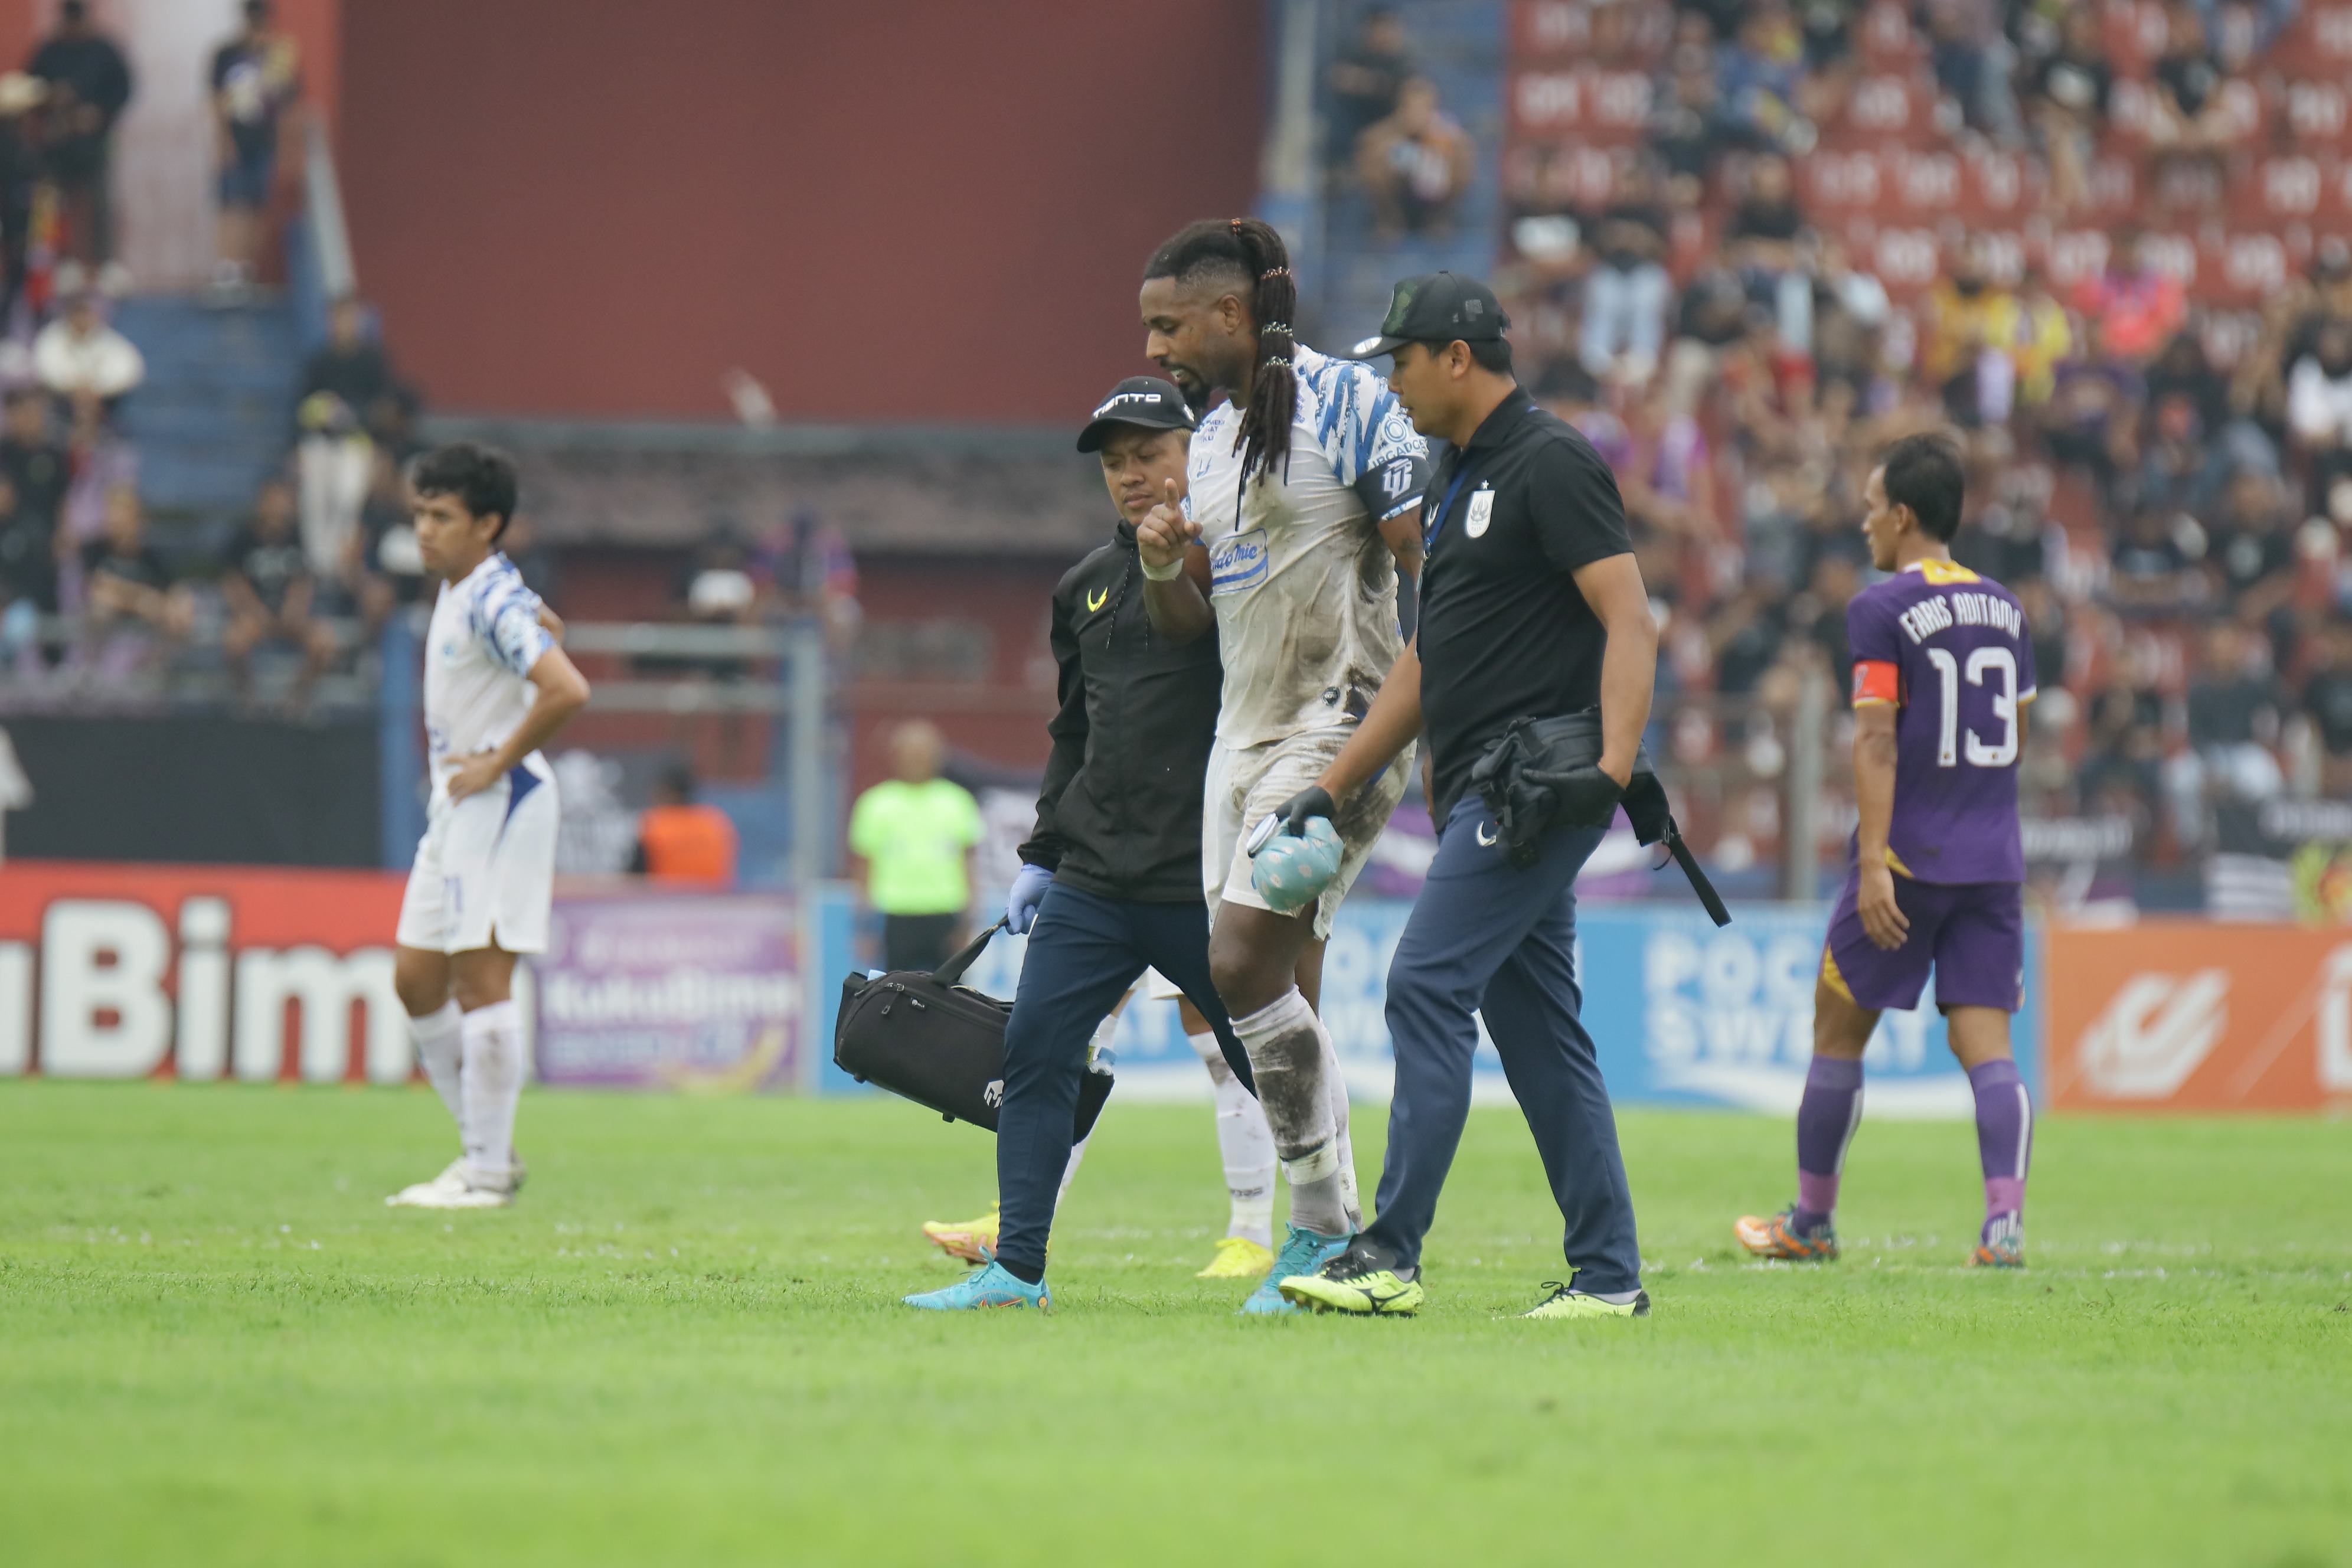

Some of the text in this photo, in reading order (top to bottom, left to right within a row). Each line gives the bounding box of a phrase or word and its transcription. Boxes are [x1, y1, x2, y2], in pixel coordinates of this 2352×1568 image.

[1899, 592, 2021, 645] FARIS ADITAMA
[1928, 646, 2019, 768] 13
